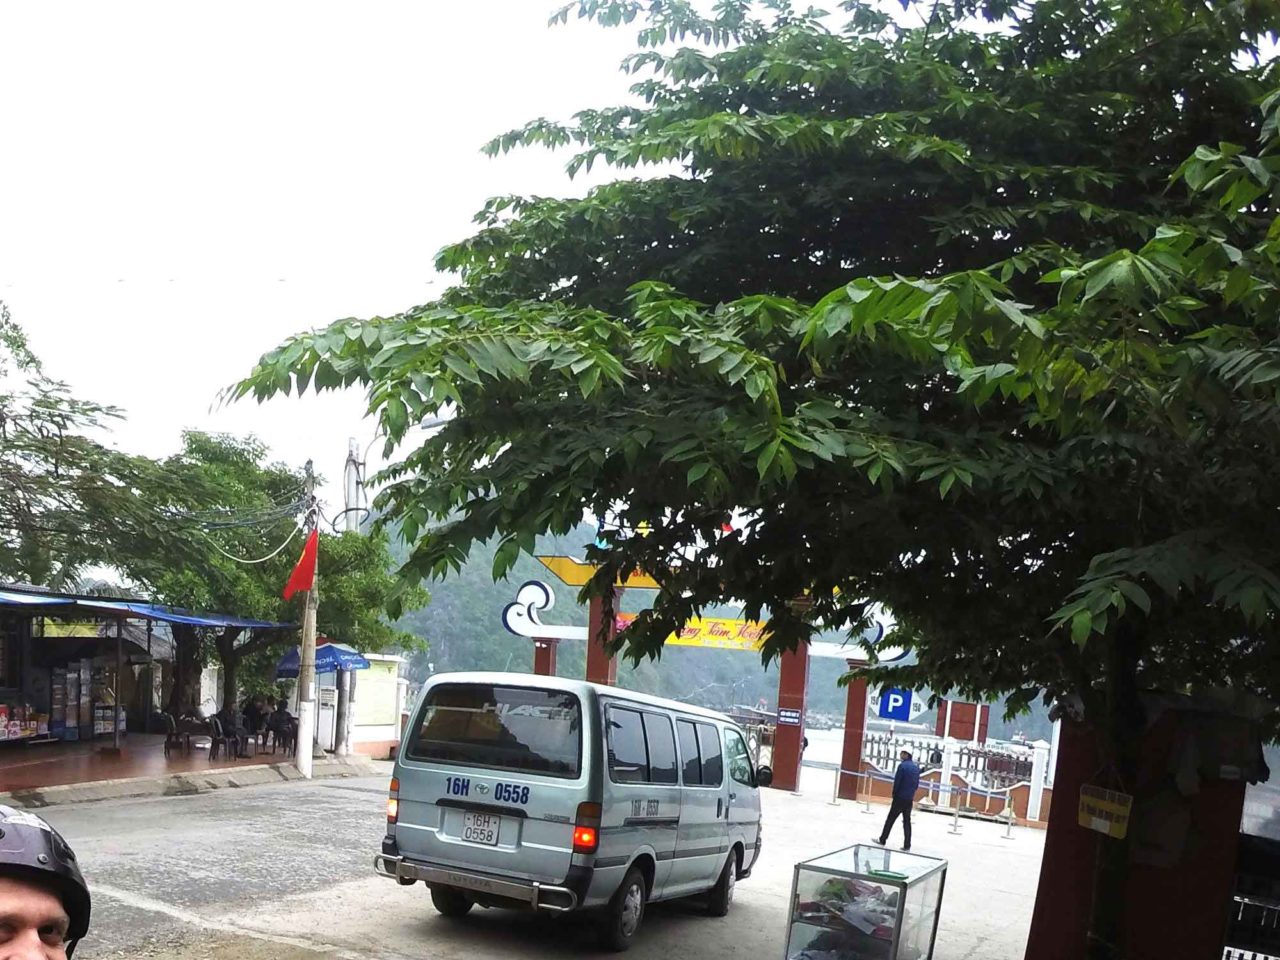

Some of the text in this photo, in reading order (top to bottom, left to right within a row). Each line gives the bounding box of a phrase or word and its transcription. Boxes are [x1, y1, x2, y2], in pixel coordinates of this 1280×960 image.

[888, 693, 904, 713] P
[446, 777, 530, 804] 16H 0558
[472, 814, 491, 829] 16H
[465, 826, 494, 842] 0558
